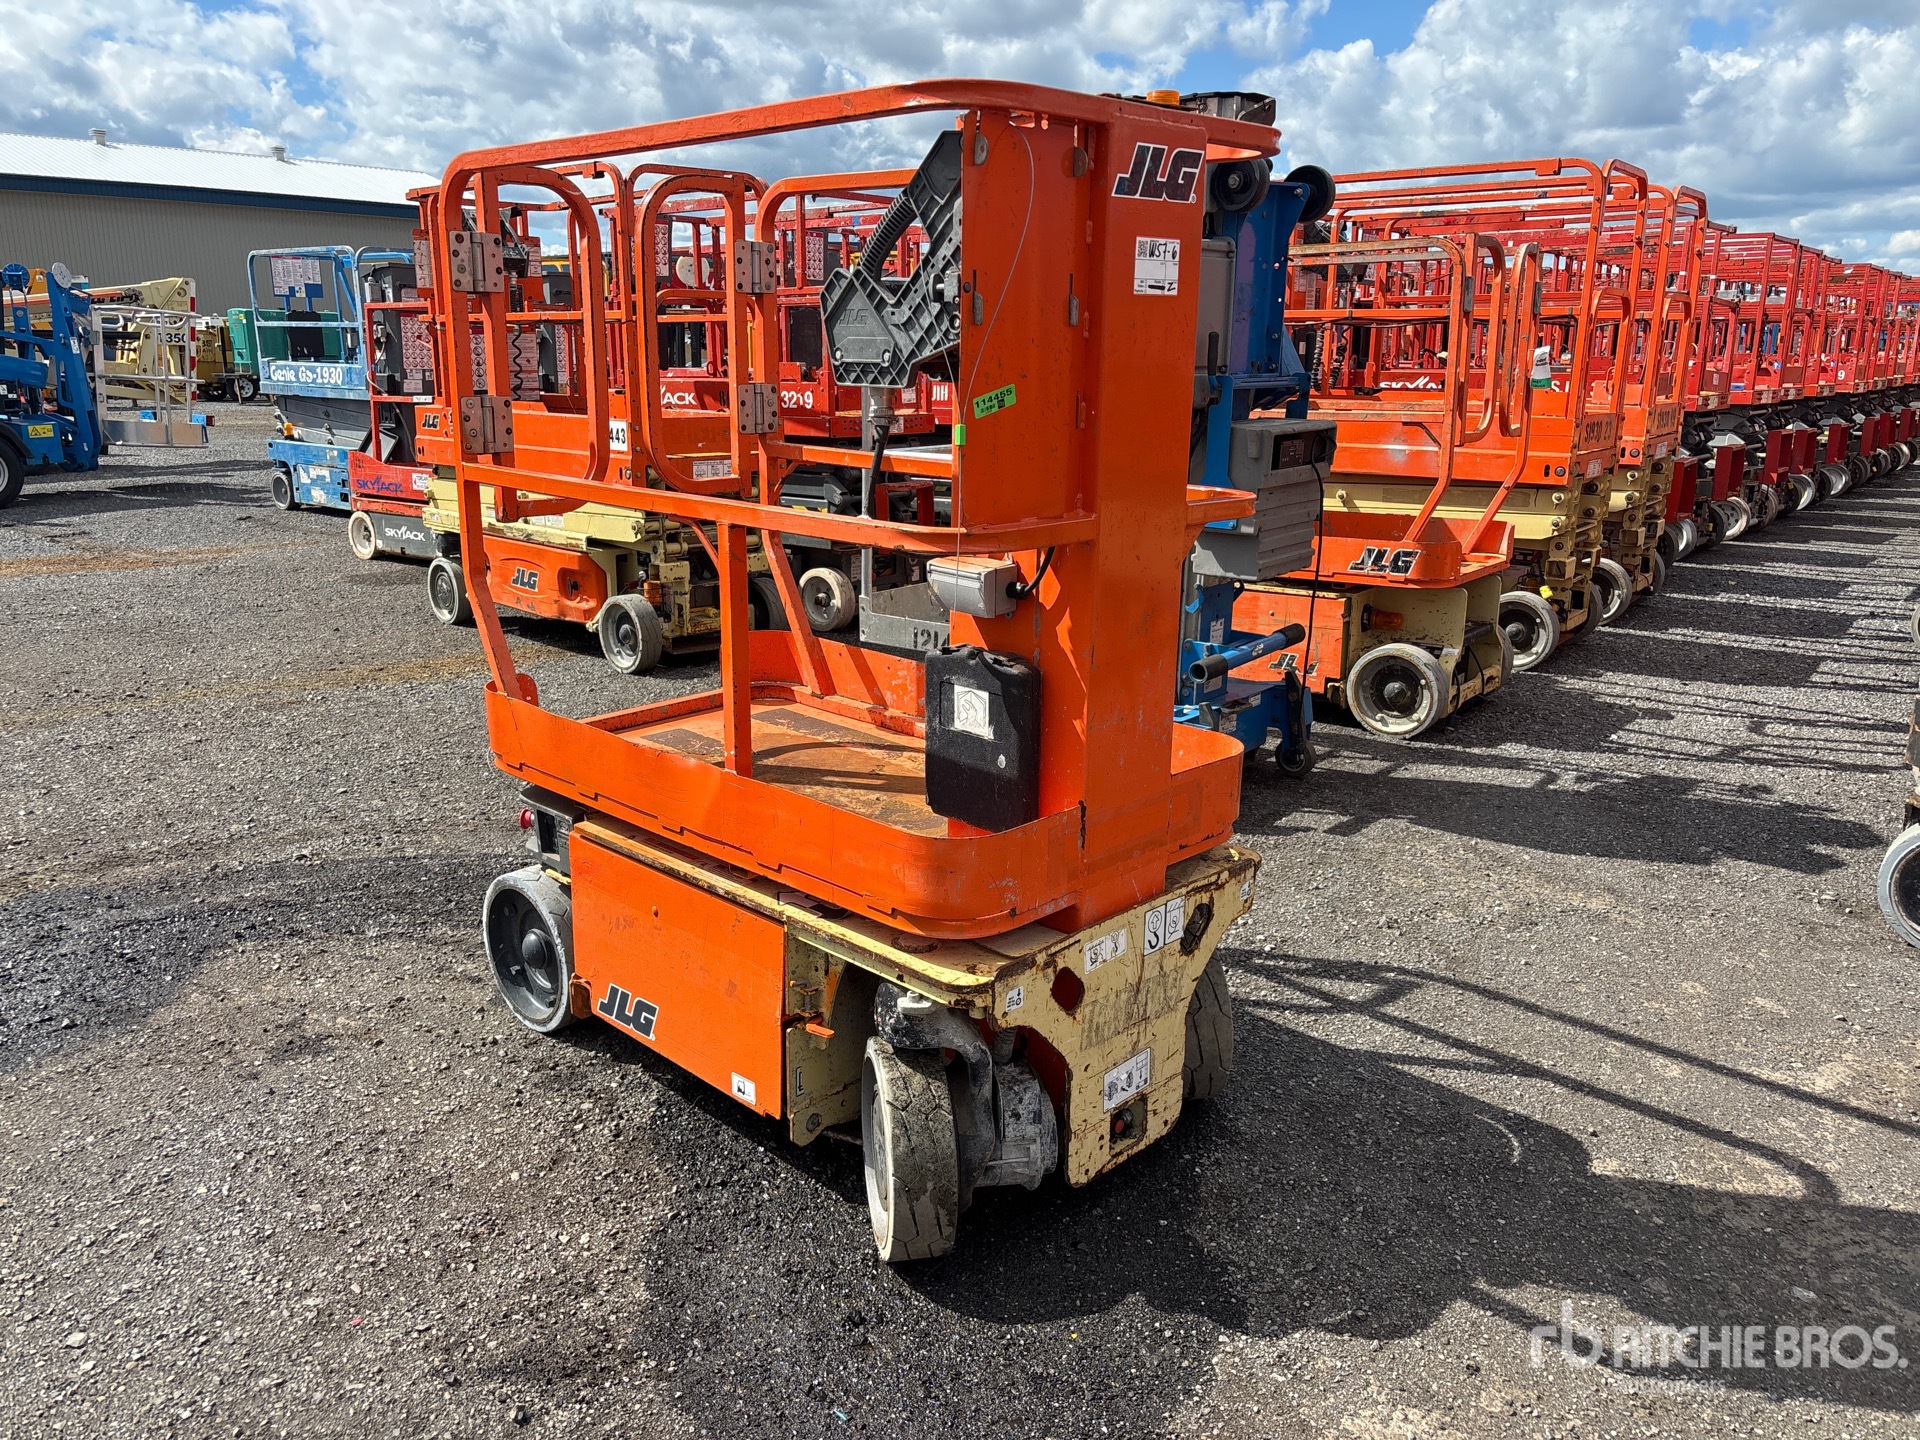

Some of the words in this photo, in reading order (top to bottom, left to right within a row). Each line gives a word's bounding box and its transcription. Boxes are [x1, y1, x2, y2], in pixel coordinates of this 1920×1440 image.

[1111, 142, 1204, 203] JLG
[269, 364, 297, 381] Genie
[780, 390, 813, 409] 3219
[974, 387, 1013, 409] 114455
[421, 413, 440, 430] JLG
[609, 427, 626, 444] 443
[355, 476, 403, 494] SKYJACK
[384, 525, 426, 542] SKYJACK
[1347, 546, 1421, 576] JLG
[511, 566, 539, 592] JLG
[1268, 652, 1319, 676] JL
[597, 982, 659, 1041] JLG
